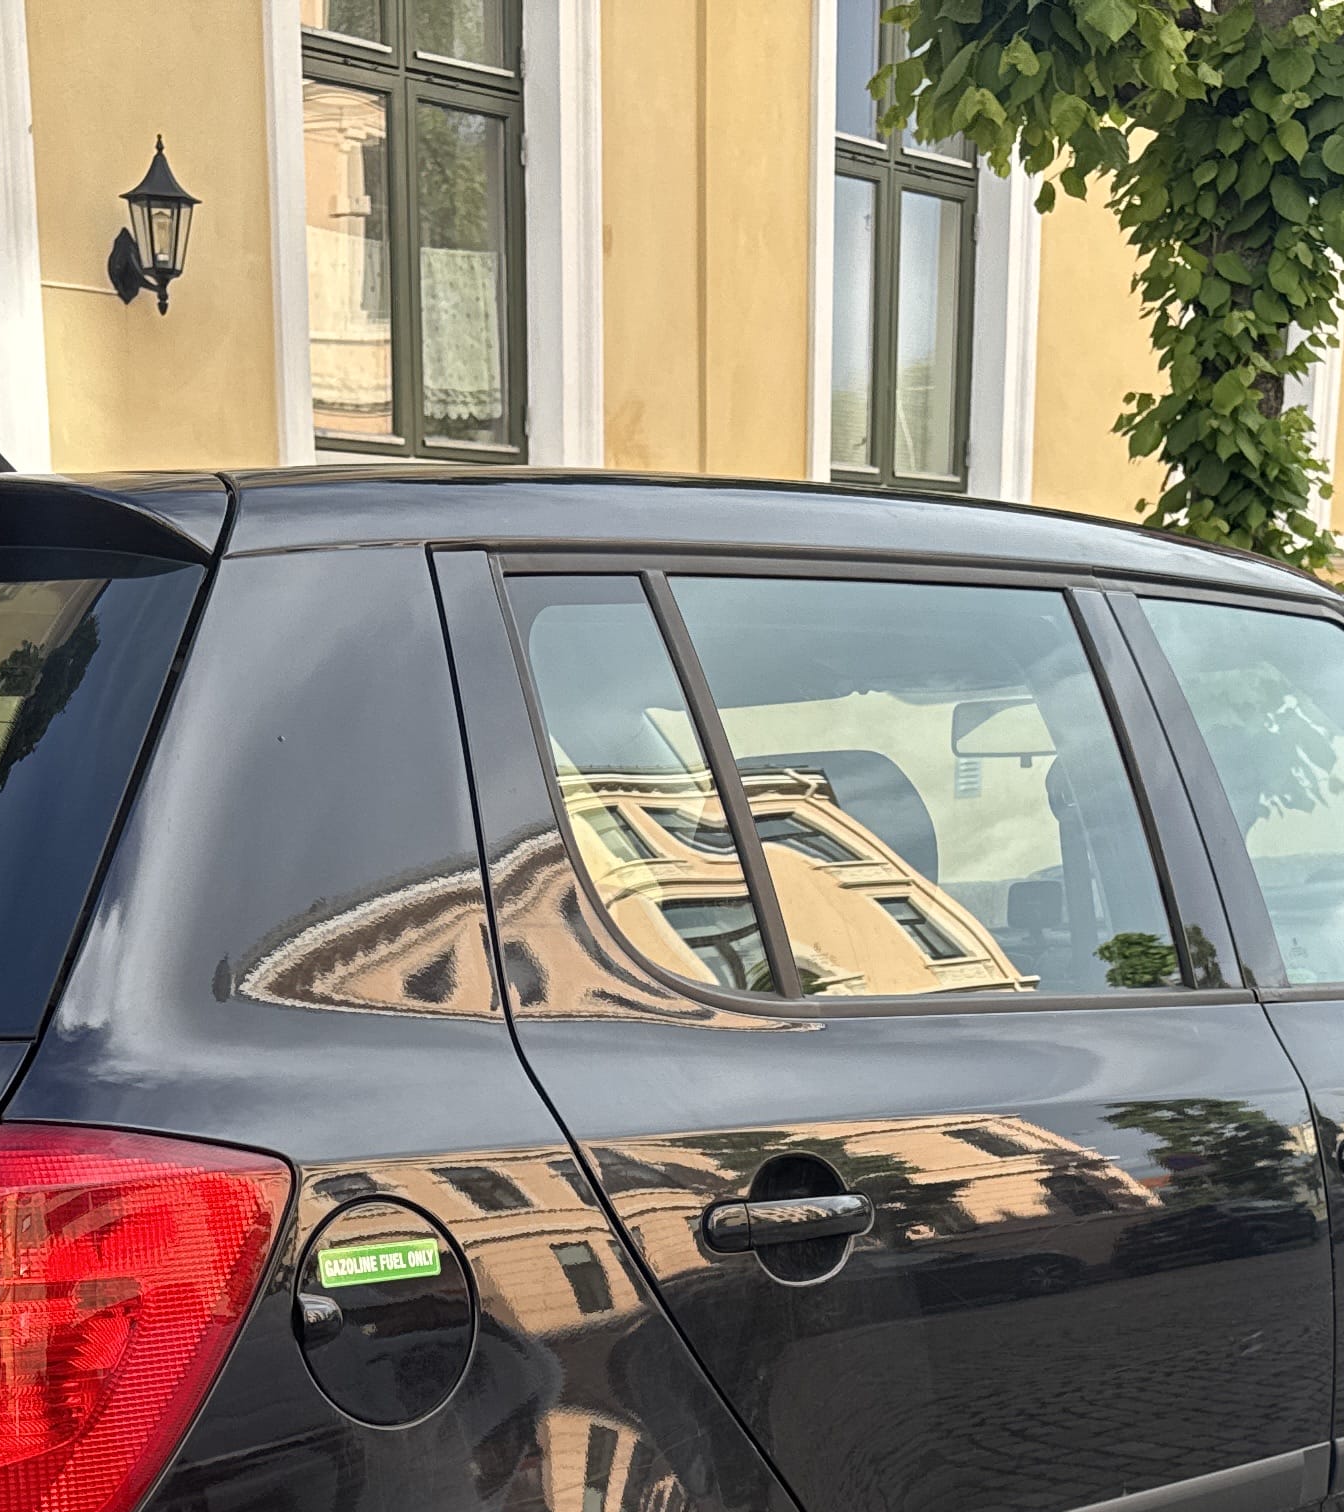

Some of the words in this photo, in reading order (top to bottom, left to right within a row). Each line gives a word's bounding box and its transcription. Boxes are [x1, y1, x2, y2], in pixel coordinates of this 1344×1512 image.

[324, 1256, 379, 1277] GAZOLINE
[379, 1253, 407, 1271] FUEL
[407, 1249, 434, 1267] ONLY
